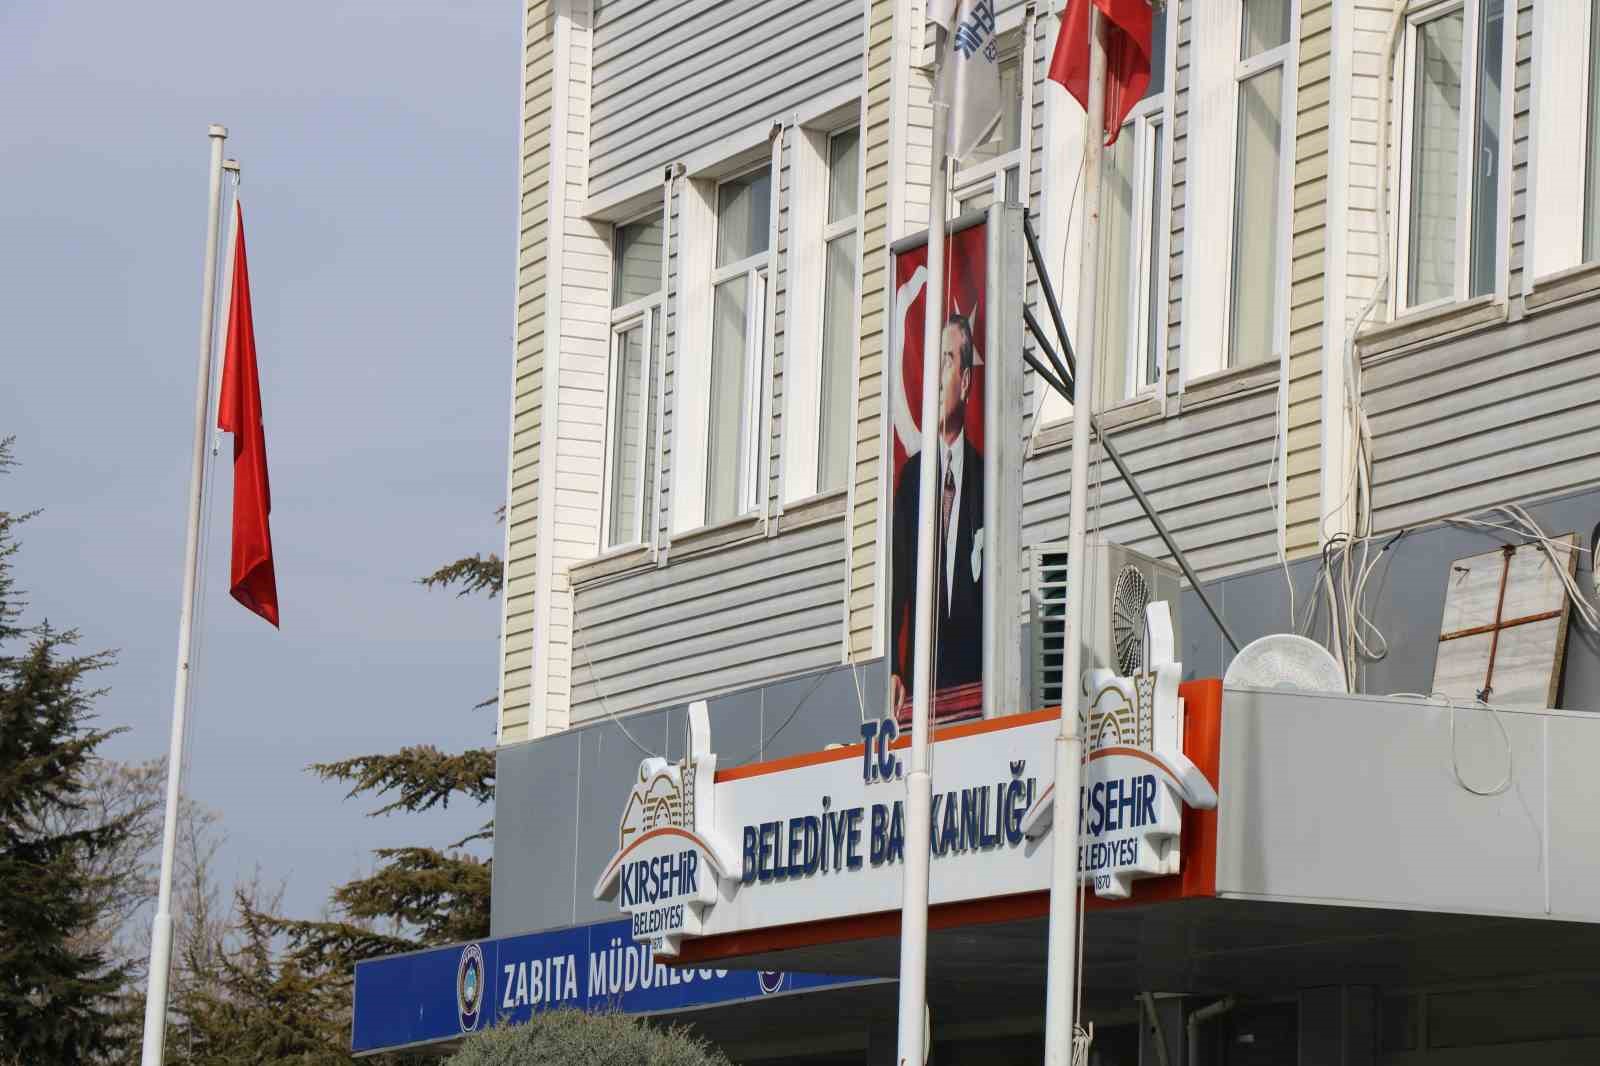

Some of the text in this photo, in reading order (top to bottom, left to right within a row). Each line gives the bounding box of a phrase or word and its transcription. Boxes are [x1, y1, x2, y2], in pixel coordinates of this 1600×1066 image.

[861, 719, 903, 783] T.C.
[742, 760, 1036, 883] BELEDİYE BAKANLIĞI
[620, 849, 697, 907] KIRŞEHİR
[1077, 838, 1138, 873] ELEDİYESİ
[633, 904, 684, 936] BELEDİYESİ
[503, 954, 578, 1008] ZABITA
